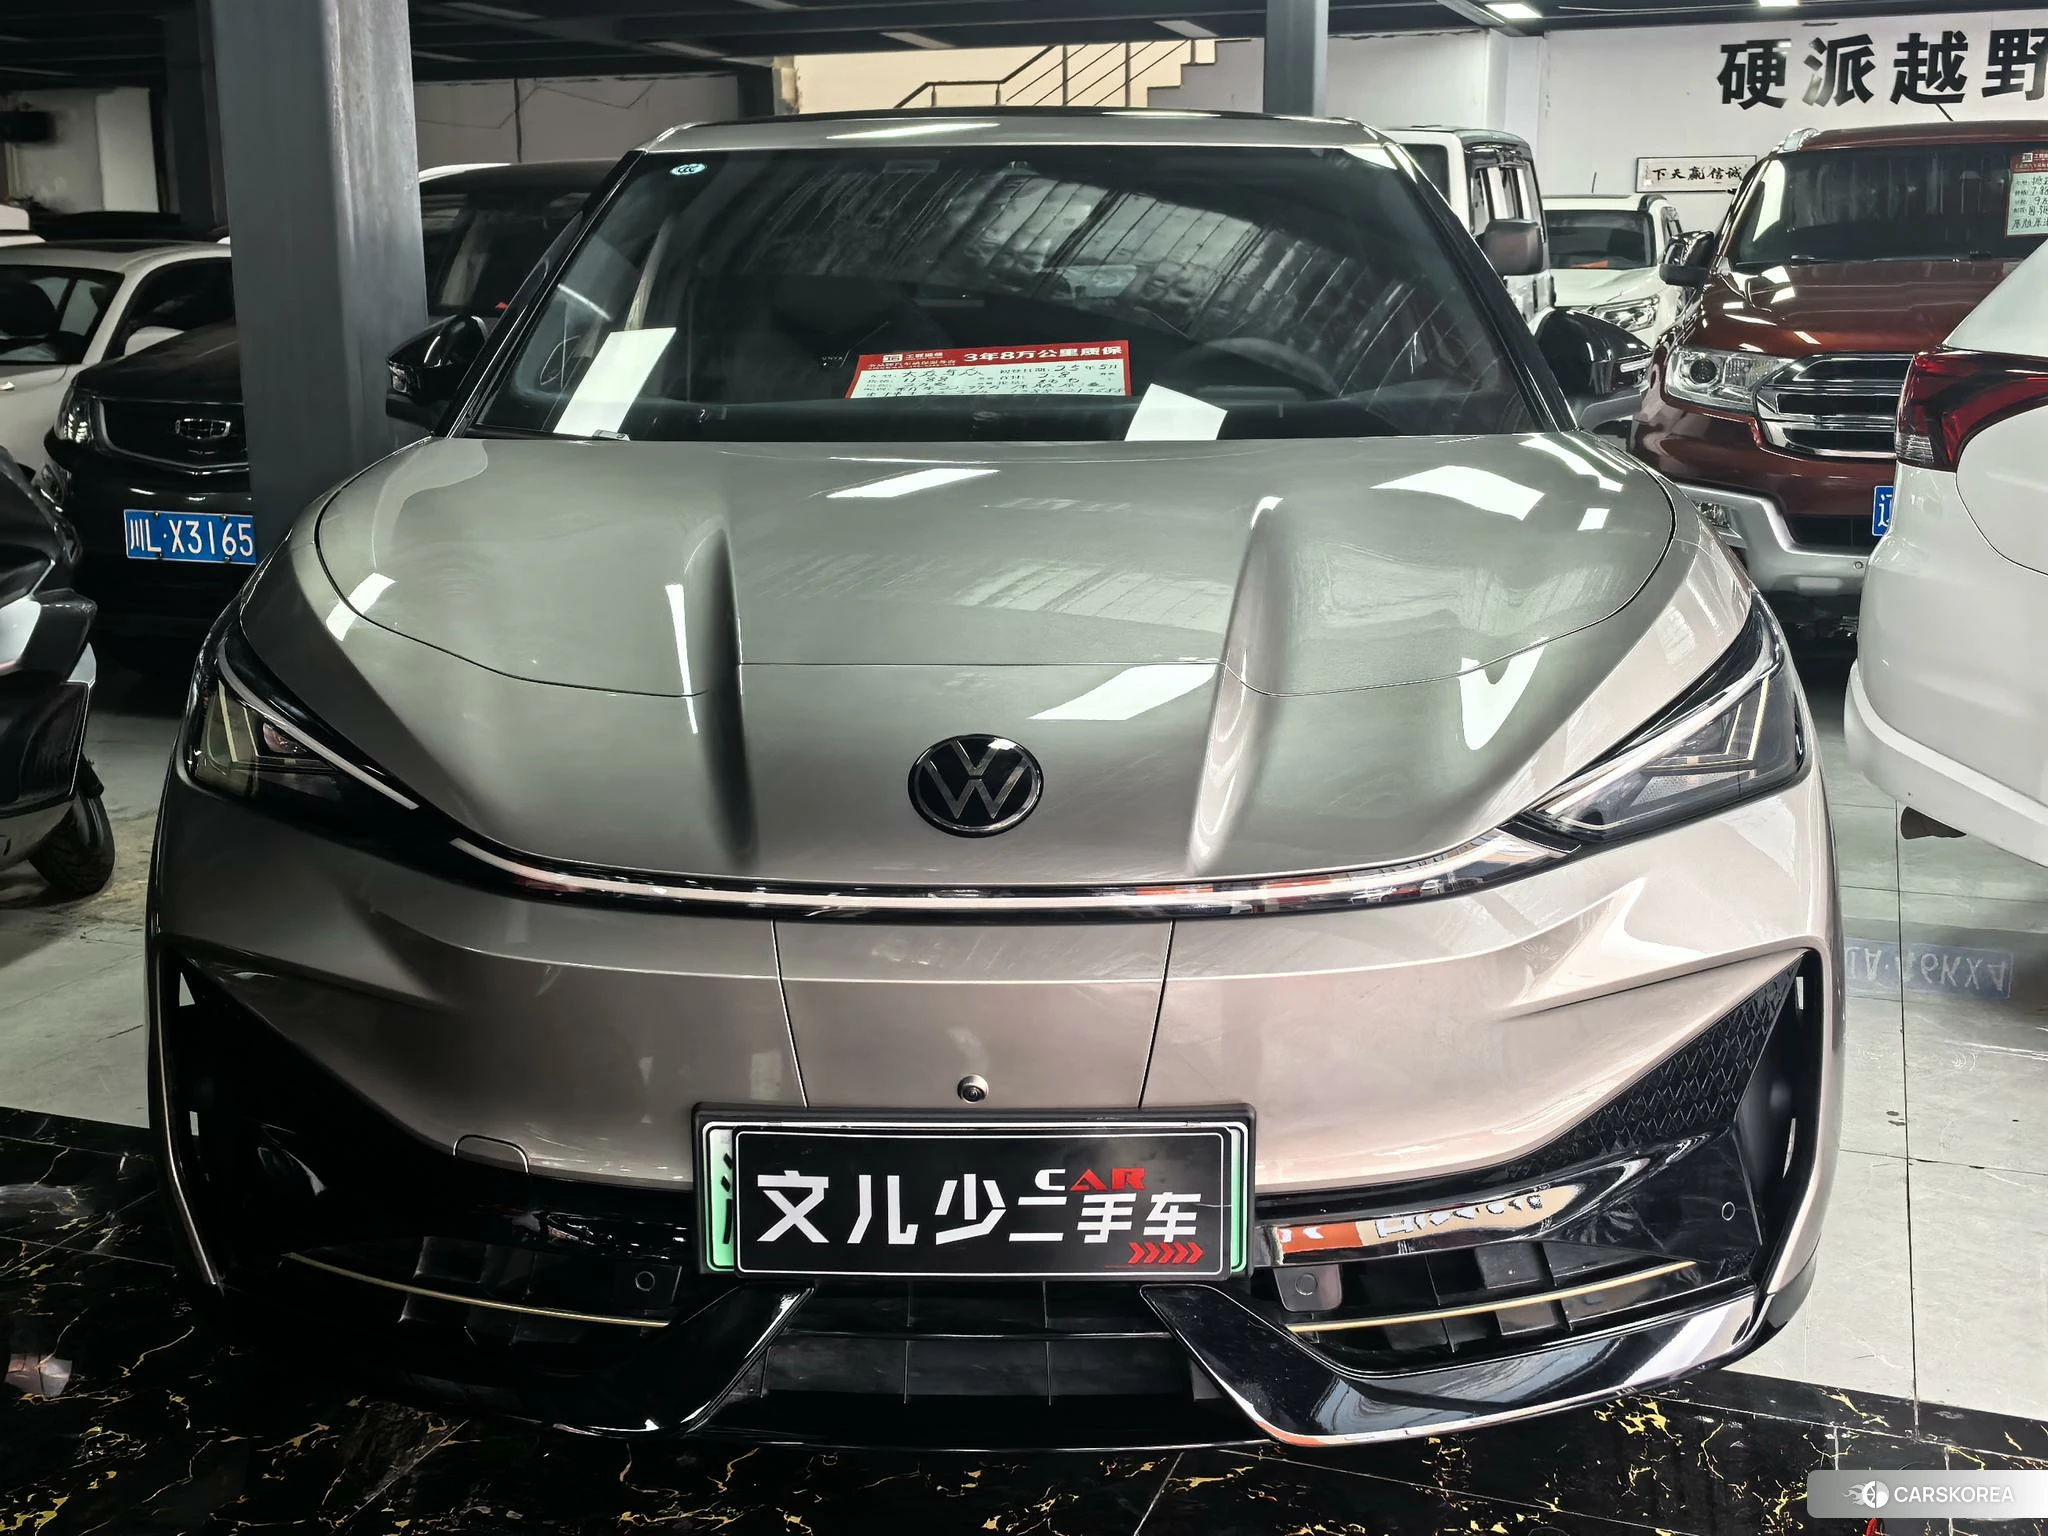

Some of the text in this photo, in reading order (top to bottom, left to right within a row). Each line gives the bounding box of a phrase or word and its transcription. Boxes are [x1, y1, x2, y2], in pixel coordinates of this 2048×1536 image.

[1717, 28, 2048, 110] 硬派越野
[964, 346, 1123, 362] 3年8万公里质保
[1034, 1168, 1146, 1191] CAR
